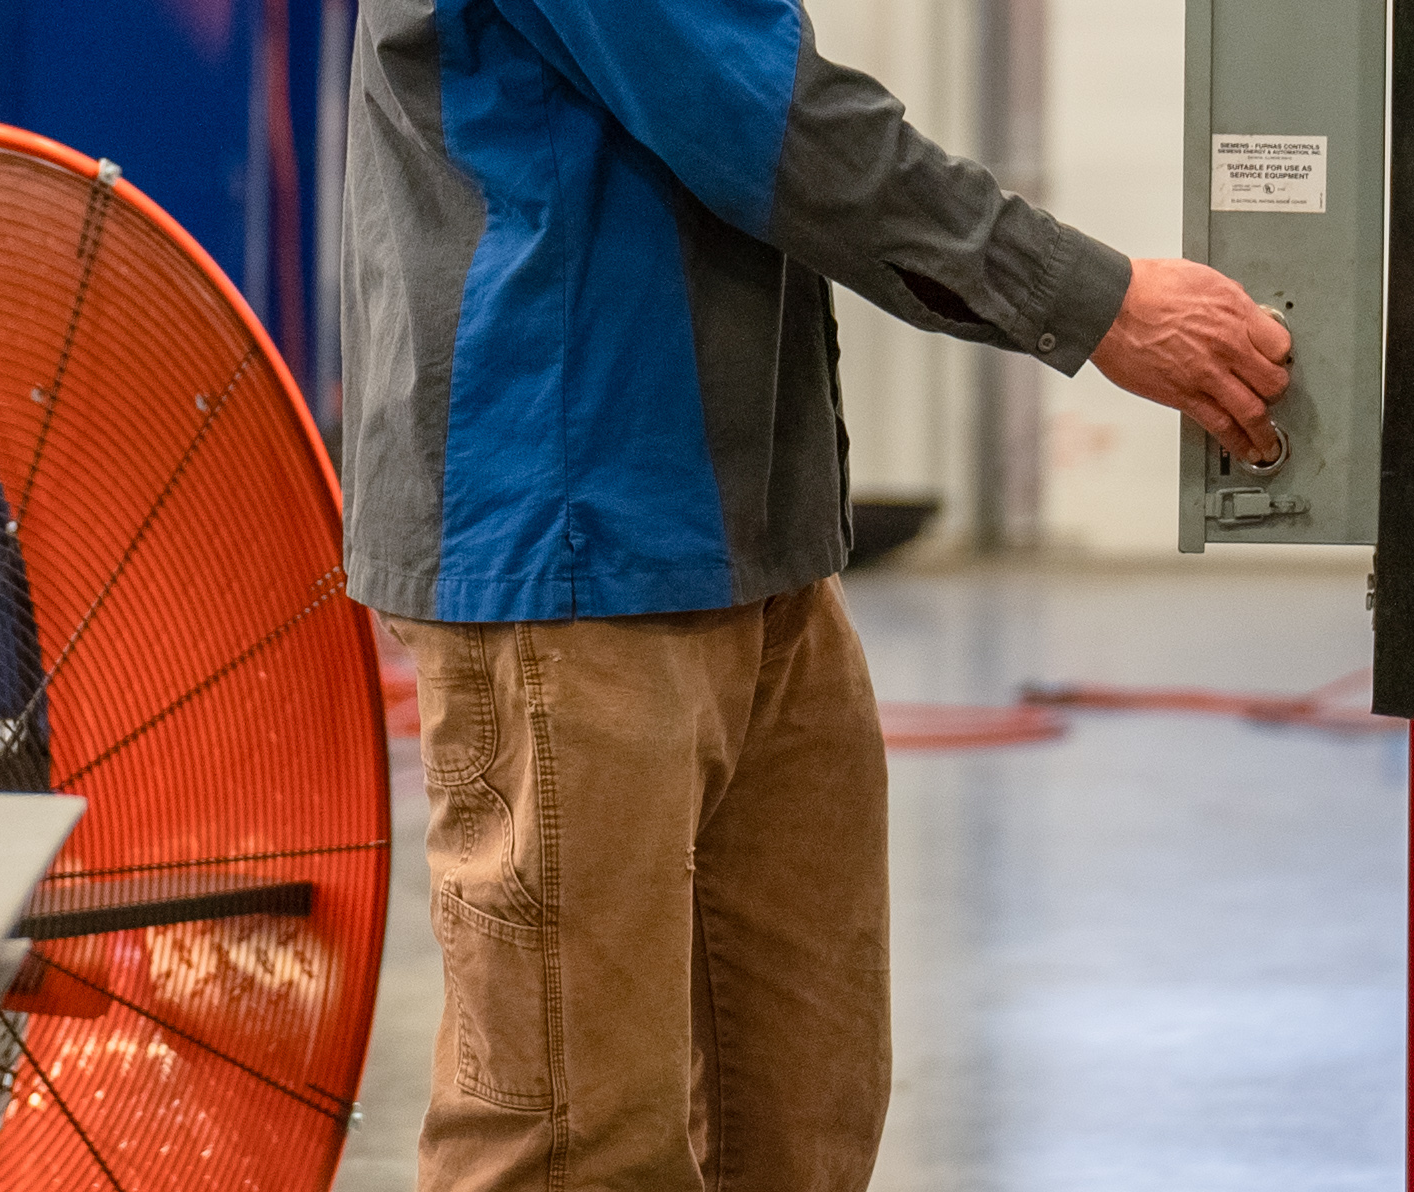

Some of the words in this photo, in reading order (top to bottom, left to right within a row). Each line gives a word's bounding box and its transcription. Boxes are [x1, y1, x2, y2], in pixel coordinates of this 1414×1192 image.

[1227, 163, 1264, 171] SUITABLE
[1284, 164, 1300, 172] USE
[1229, 171, 1263, 179] SERVICE
[1264, 172, 1309, 180] EQUIPMENT
